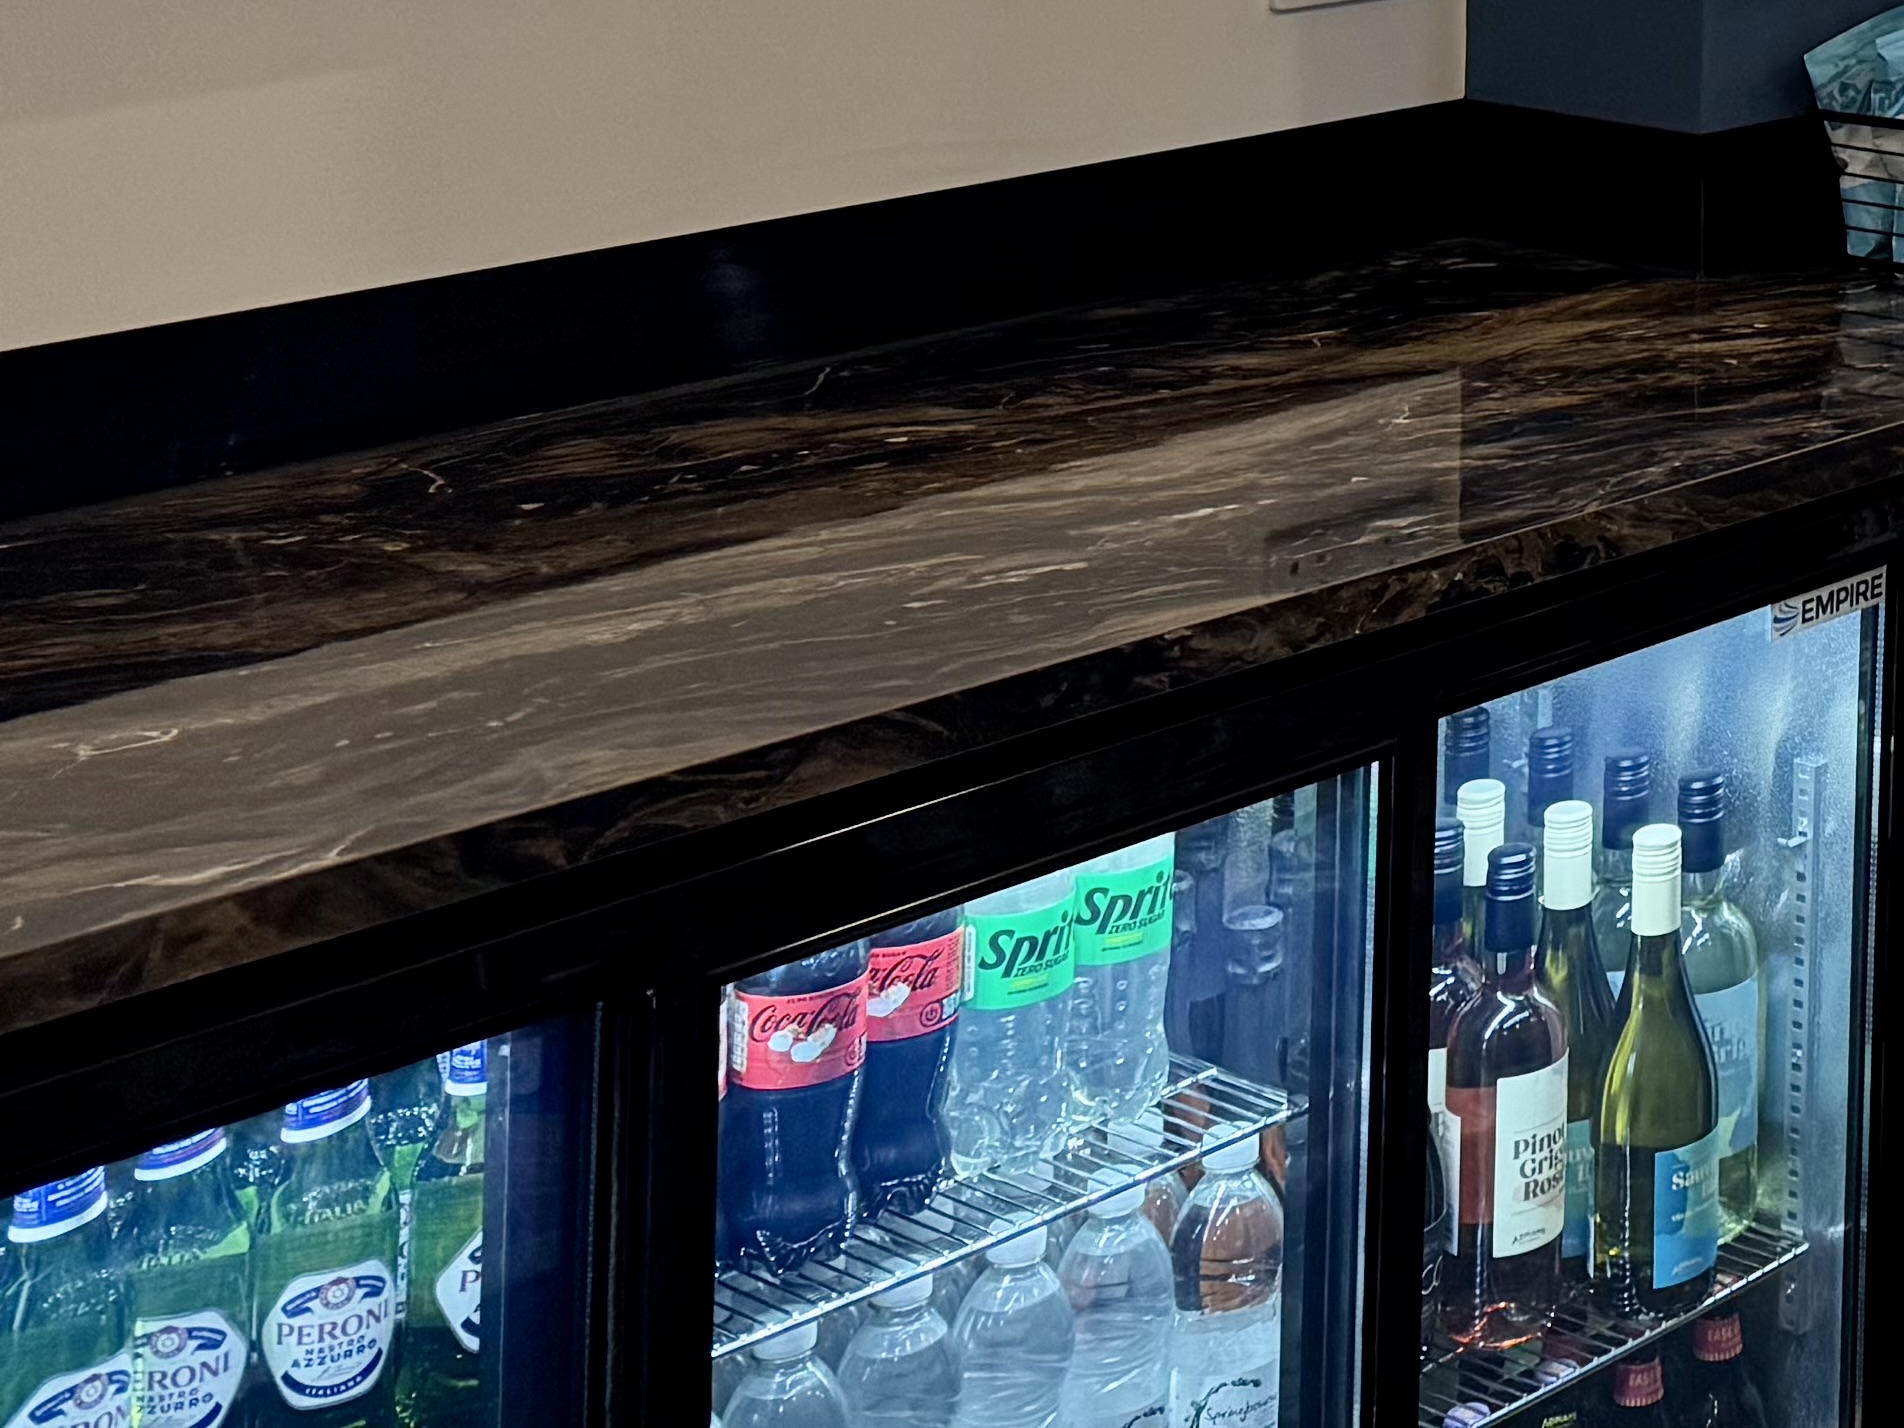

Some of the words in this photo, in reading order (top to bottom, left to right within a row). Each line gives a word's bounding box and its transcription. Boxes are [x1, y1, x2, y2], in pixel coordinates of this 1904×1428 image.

[1801, 573, 1885, 624] EMPIRE
[1108, 918, 1137, 935] ZERO
[1015, 961, 1043, 977] ZERO
[276, 1301, 391, 1348] PERONI
[291, 1338, 380, 1370] AZZURRO
[303, 1334, 367, 1358] NASTRO
[146, 1350, 232, 1391] RONI
